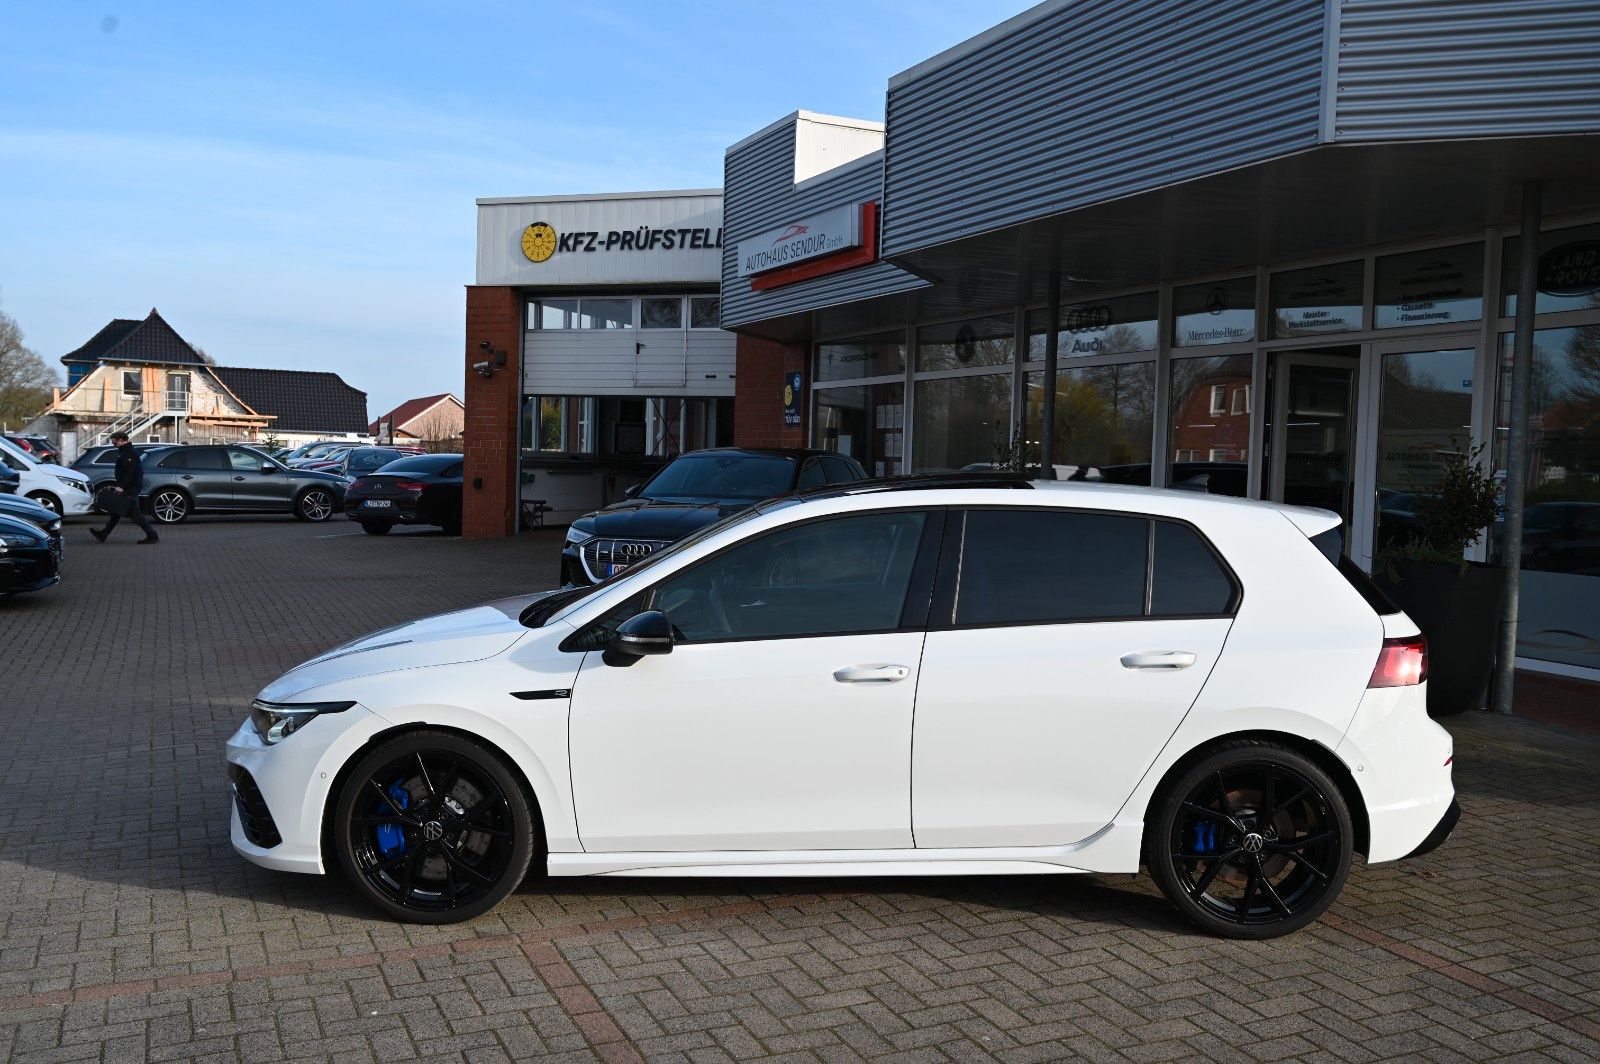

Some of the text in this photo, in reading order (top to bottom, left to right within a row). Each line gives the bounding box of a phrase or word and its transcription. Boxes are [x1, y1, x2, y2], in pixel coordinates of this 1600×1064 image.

[559, 225, 723, 252] KFZ-PRÜFSTELL
[745, 245, 788, 271] AUTOHAUS
[790, 233, 826, 259] SENDUR
[1554, 269, 1600, 285] ROVE
[1189, 327, 1245, 341] Mercedes-Benz
[1071, 337, 1103, 353] Audi
